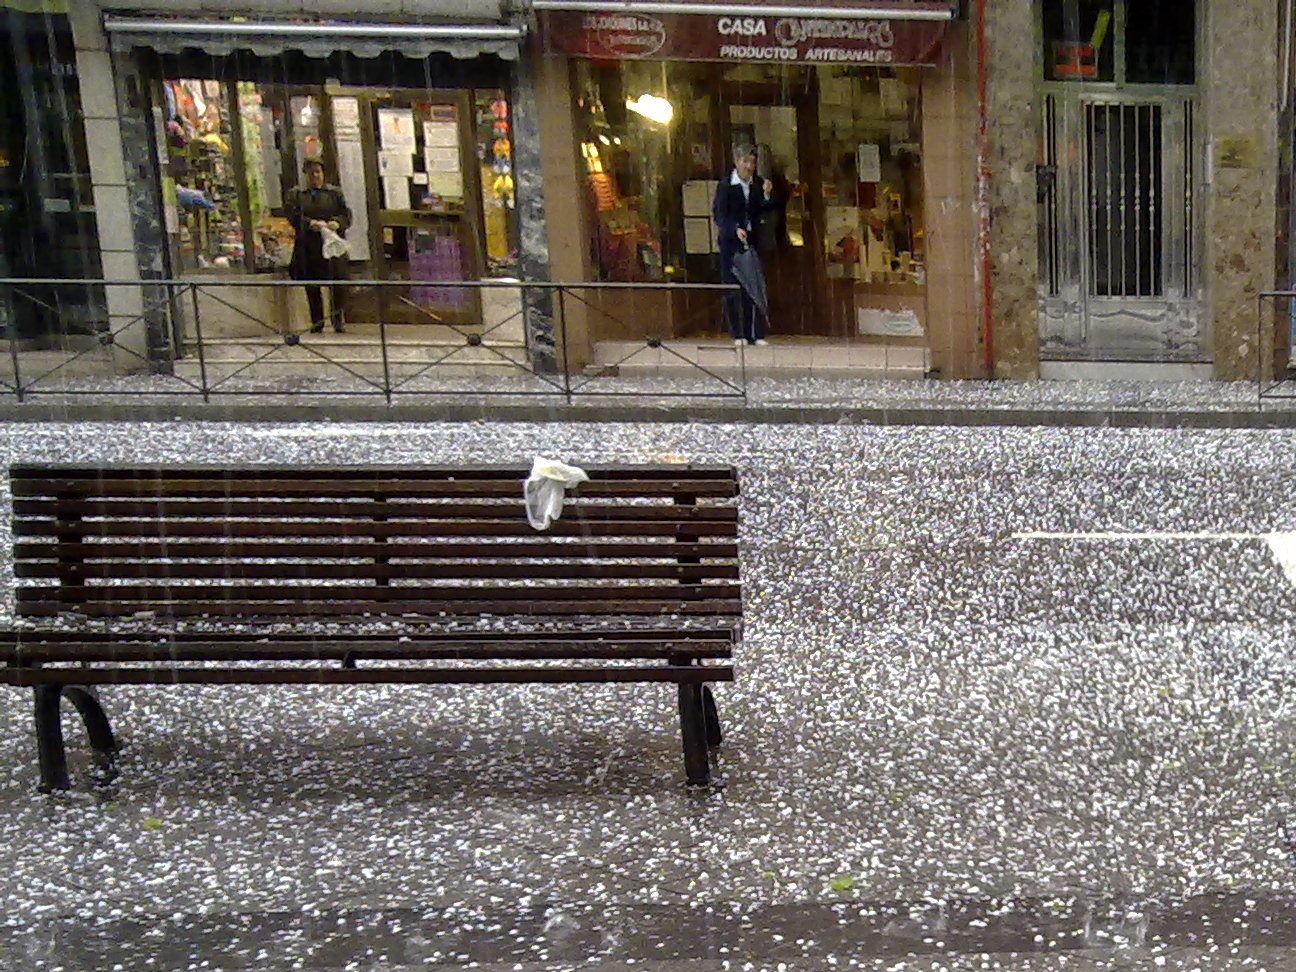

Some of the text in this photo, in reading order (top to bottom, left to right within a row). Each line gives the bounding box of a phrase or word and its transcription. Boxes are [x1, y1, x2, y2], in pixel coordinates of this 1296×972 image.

[717, 18, 767, 36] CASA
[719, 46, 892, 63] PRODUCTOS ARTESANALES
